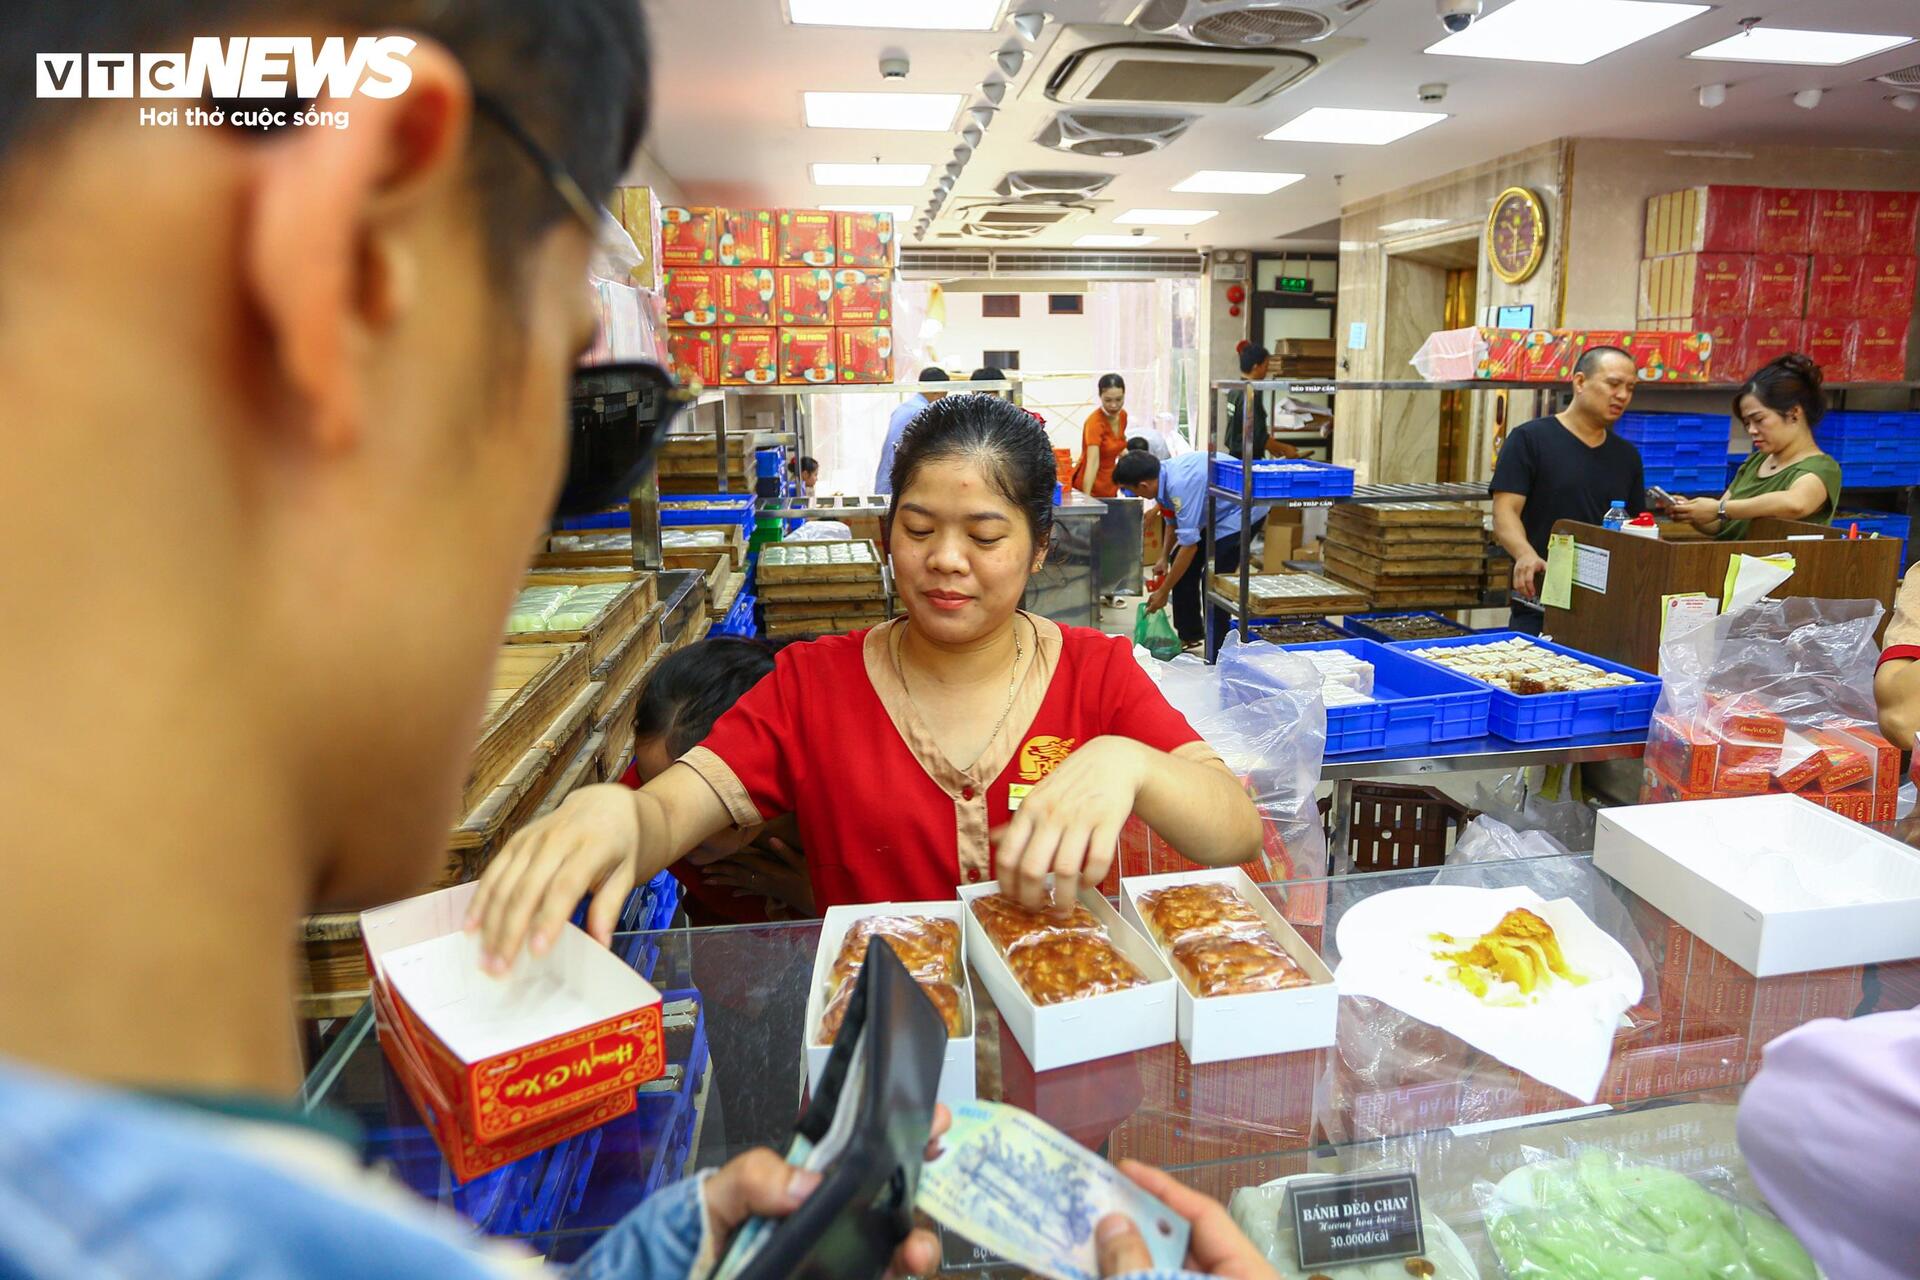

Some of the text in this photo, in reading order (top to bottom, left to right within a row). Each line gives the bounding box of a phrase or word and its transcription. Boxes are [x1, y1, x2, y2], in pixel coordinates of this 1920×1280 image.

[1302, 1196, 1408, 1222] BÁNH DẺO CHAY
